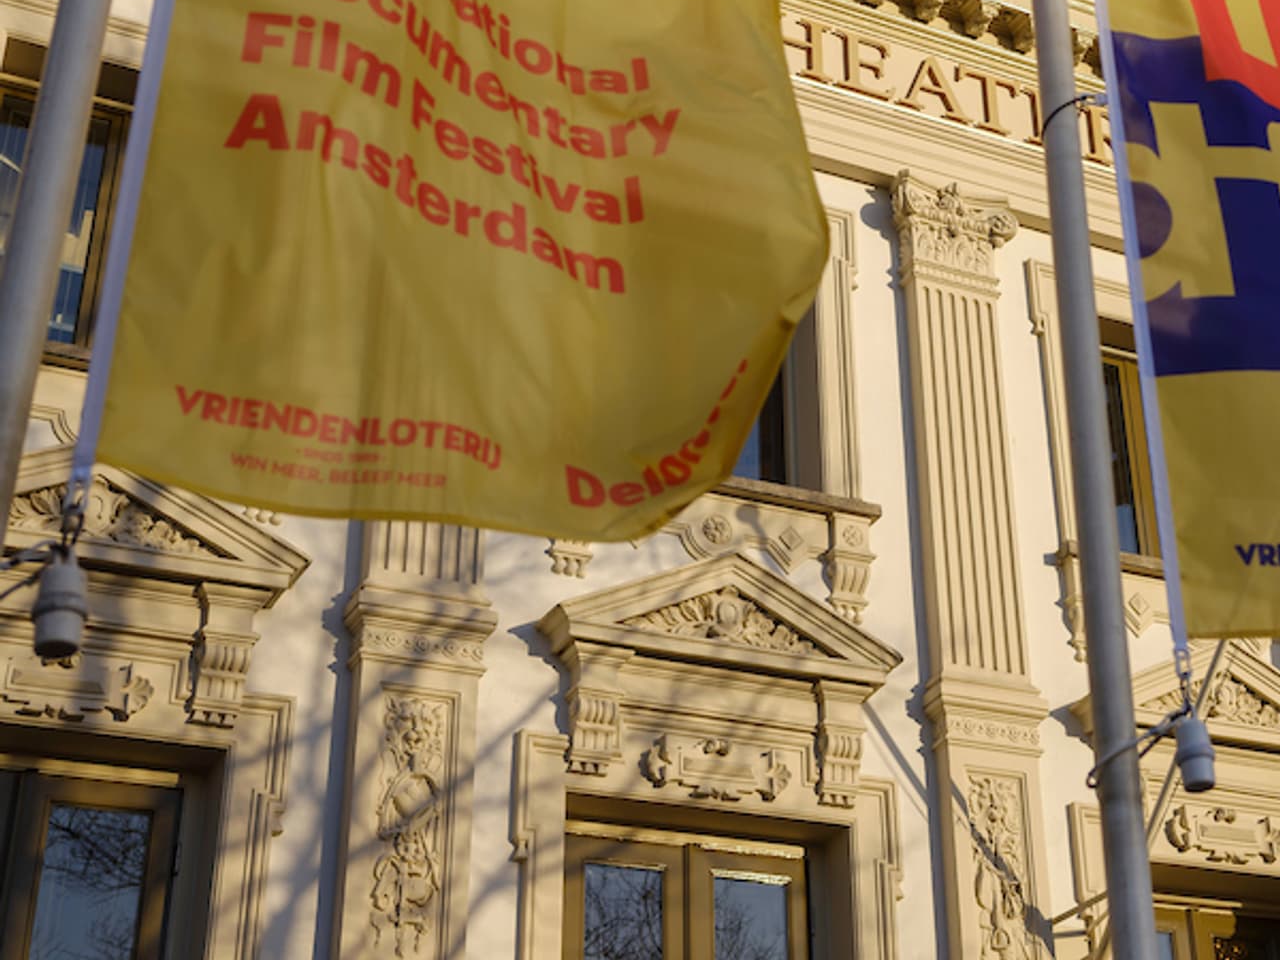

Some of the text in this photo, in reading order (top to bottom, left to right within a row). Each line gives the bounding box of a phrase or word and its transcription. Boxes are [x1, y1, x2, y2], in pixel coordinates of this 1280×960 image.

[223, 93, 627, 294] Amsterdam
[241, 11, 645, 225] Film Festival
[175, 384, 503, 470] VRIENDENLOTERIJ
